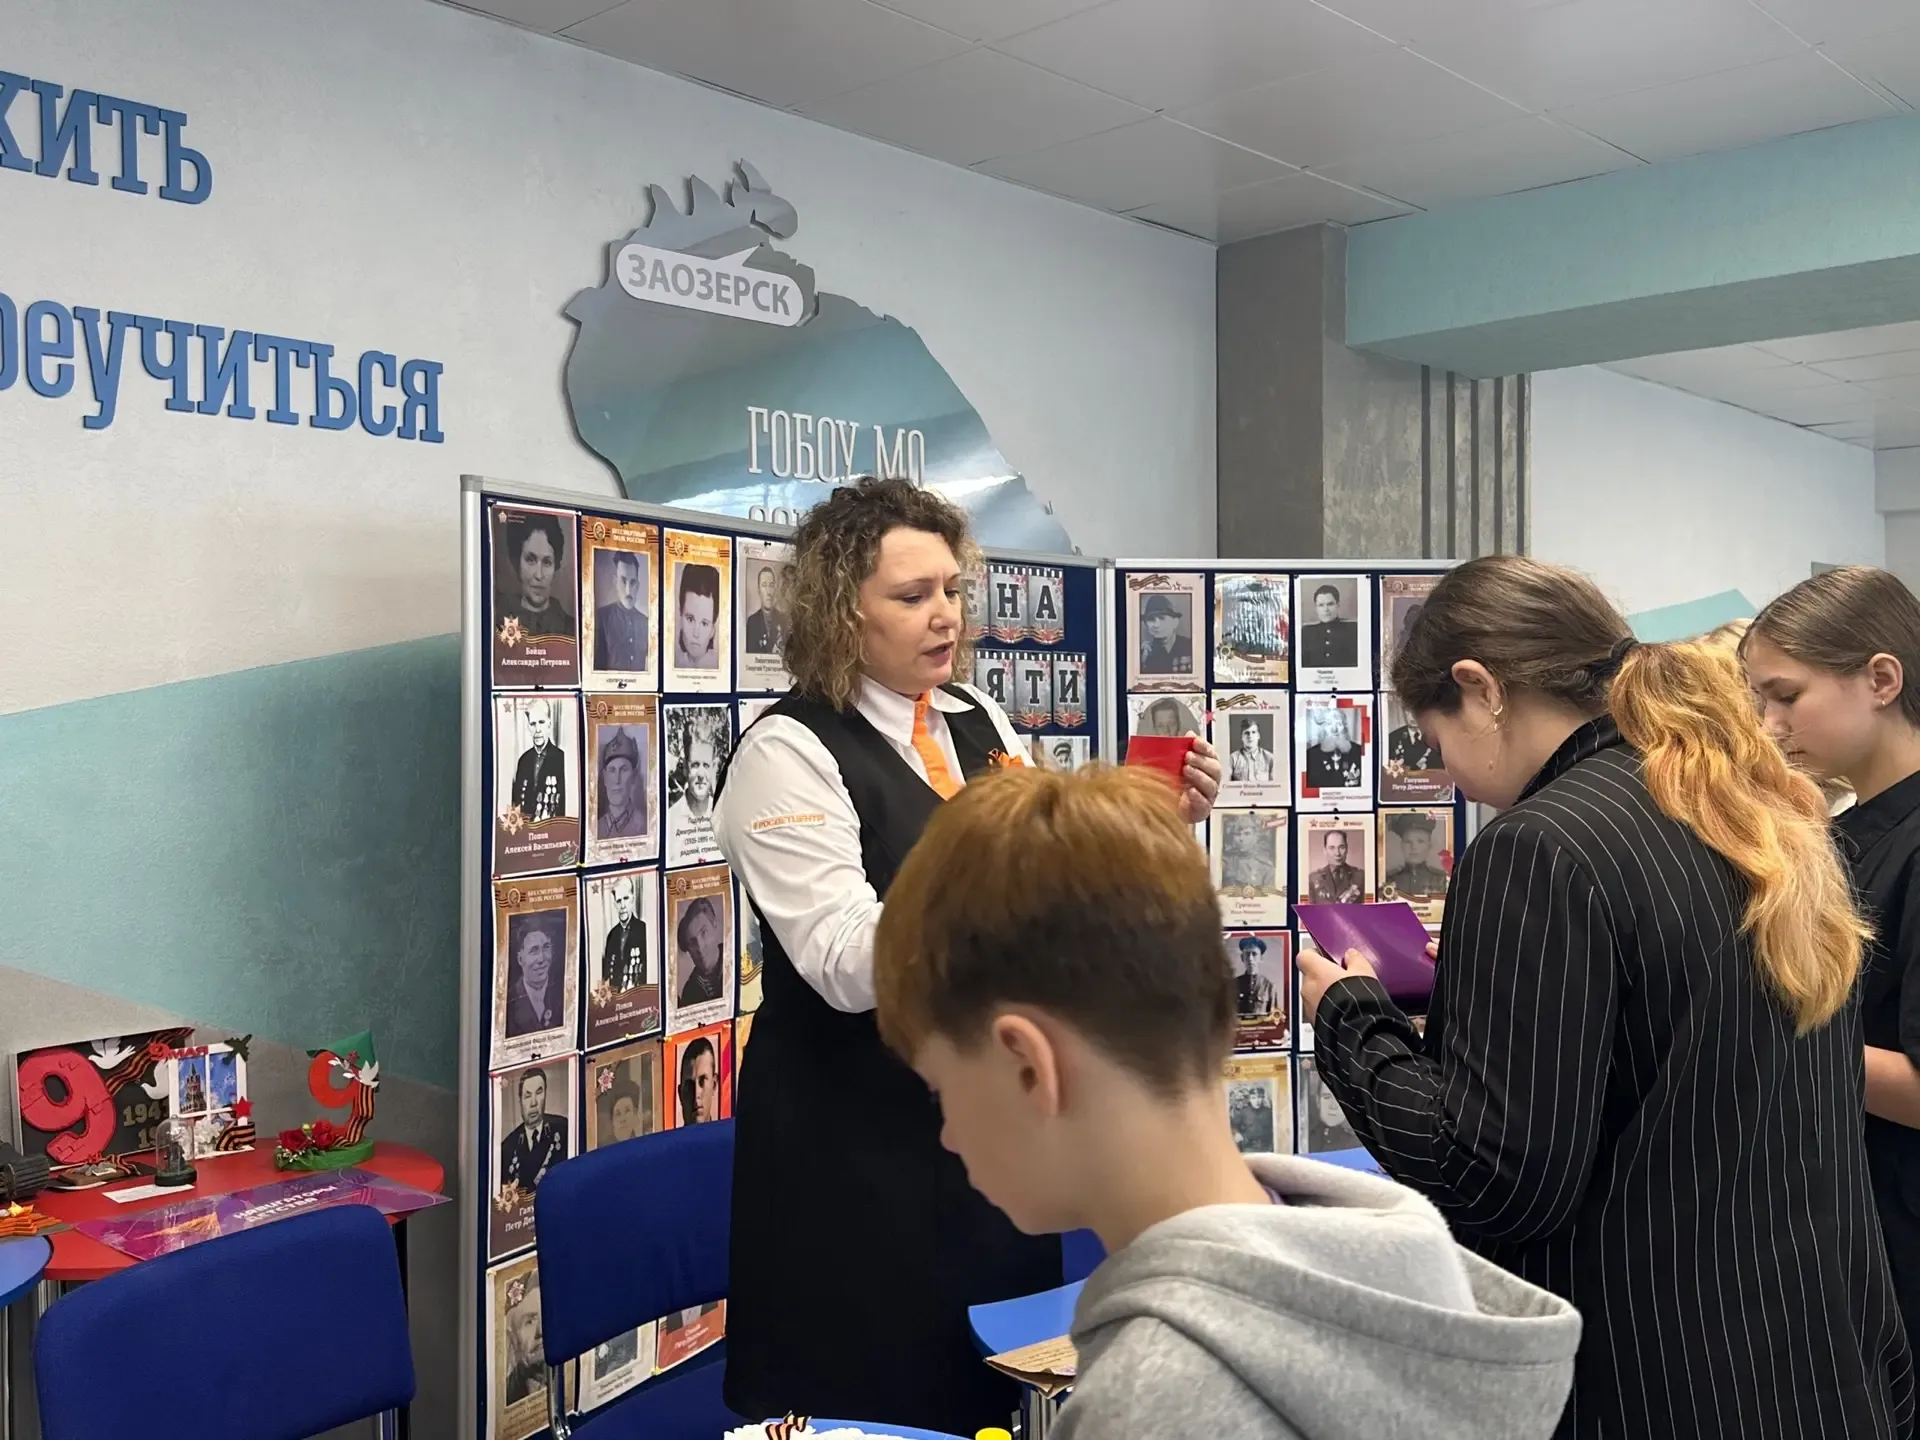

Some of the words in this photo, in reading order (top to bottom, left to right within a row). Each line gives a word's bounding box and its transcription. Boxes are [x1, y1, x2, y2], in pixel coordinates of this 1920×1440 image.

[627, 253, 791, 317] ЗАОЗЕРСК
[747, 405, 859, 484] ГОБОУ
[872, 423, 926, 488] МО
[501, 658, 539, 667] Александра
[540, 658, 571, 667] Петровна
[504, 843, 532, 854] Алексей
[533, 840, 571, 851] Васильевич
[528, 832, 549, 841] Попов
[149, 1043, 170, 1061] 9
[168, 1046, 209, 1059] МАЯ
[19, 1049, 117, 1165] 9
[233, 1185, 338, 1219] НАВИГАТОРЫ
[246, 1197, 318, 1222] ДЕТСТВА
